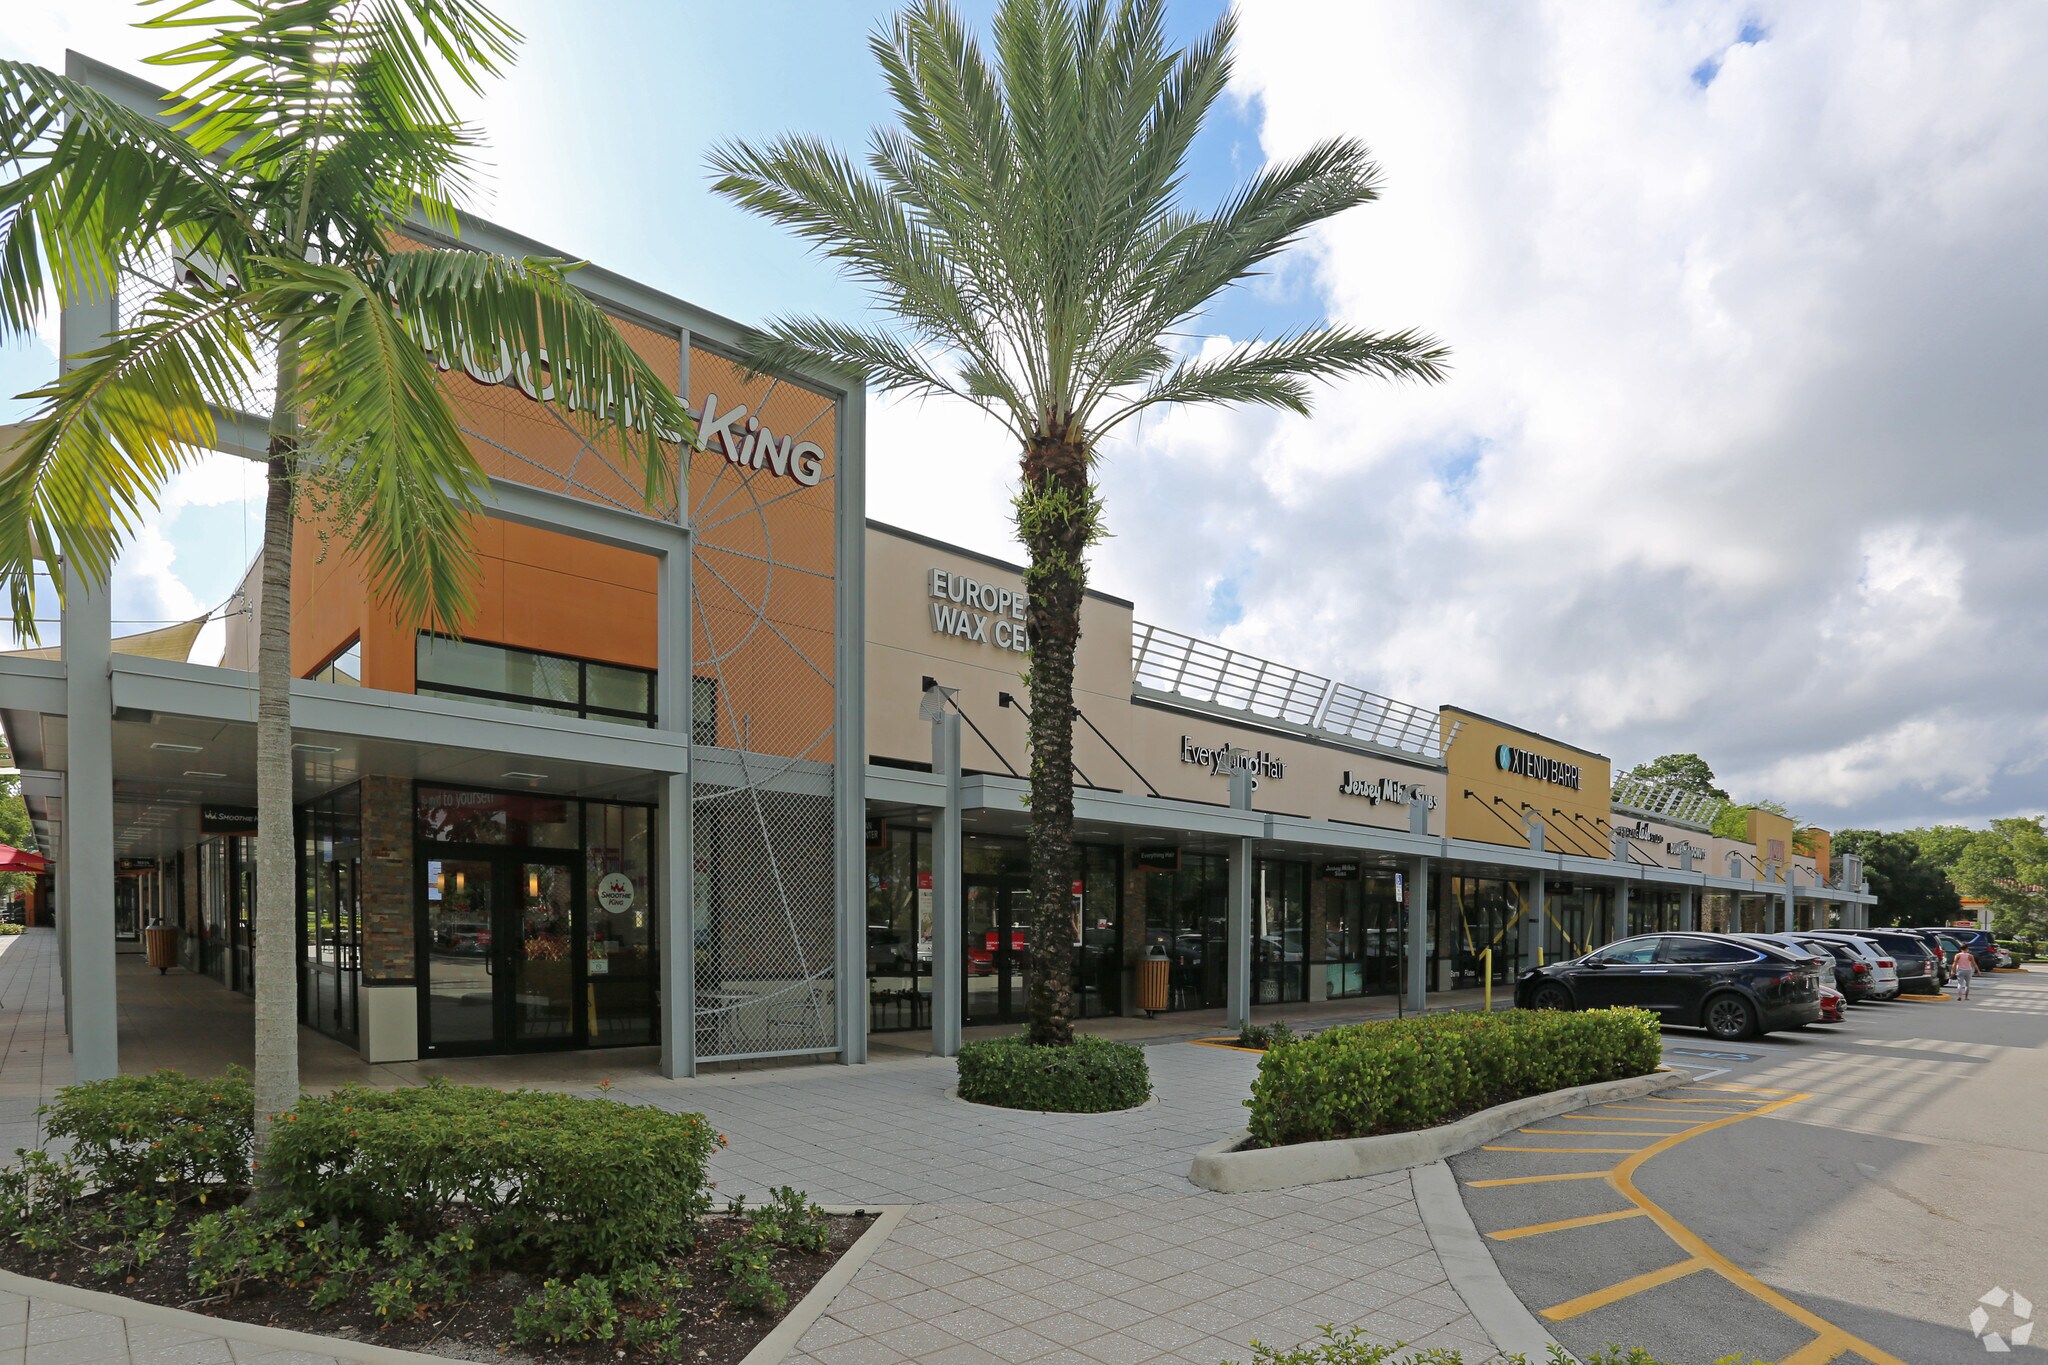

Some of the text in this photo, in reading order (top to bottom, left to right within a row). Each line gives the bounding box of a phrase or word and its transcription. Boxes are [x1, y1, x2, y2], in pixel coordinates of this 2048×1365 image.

[929, 568, 1030, 621] EUROPE
[930, 603, 988, 643] WAX
[1340, 771, 1381, 805] Jersey
[1381, 779, 1412, 804] Mik'
[1510, 748, 1583, 790] XTEND BARRE
[443, 791, 453, 807] to
